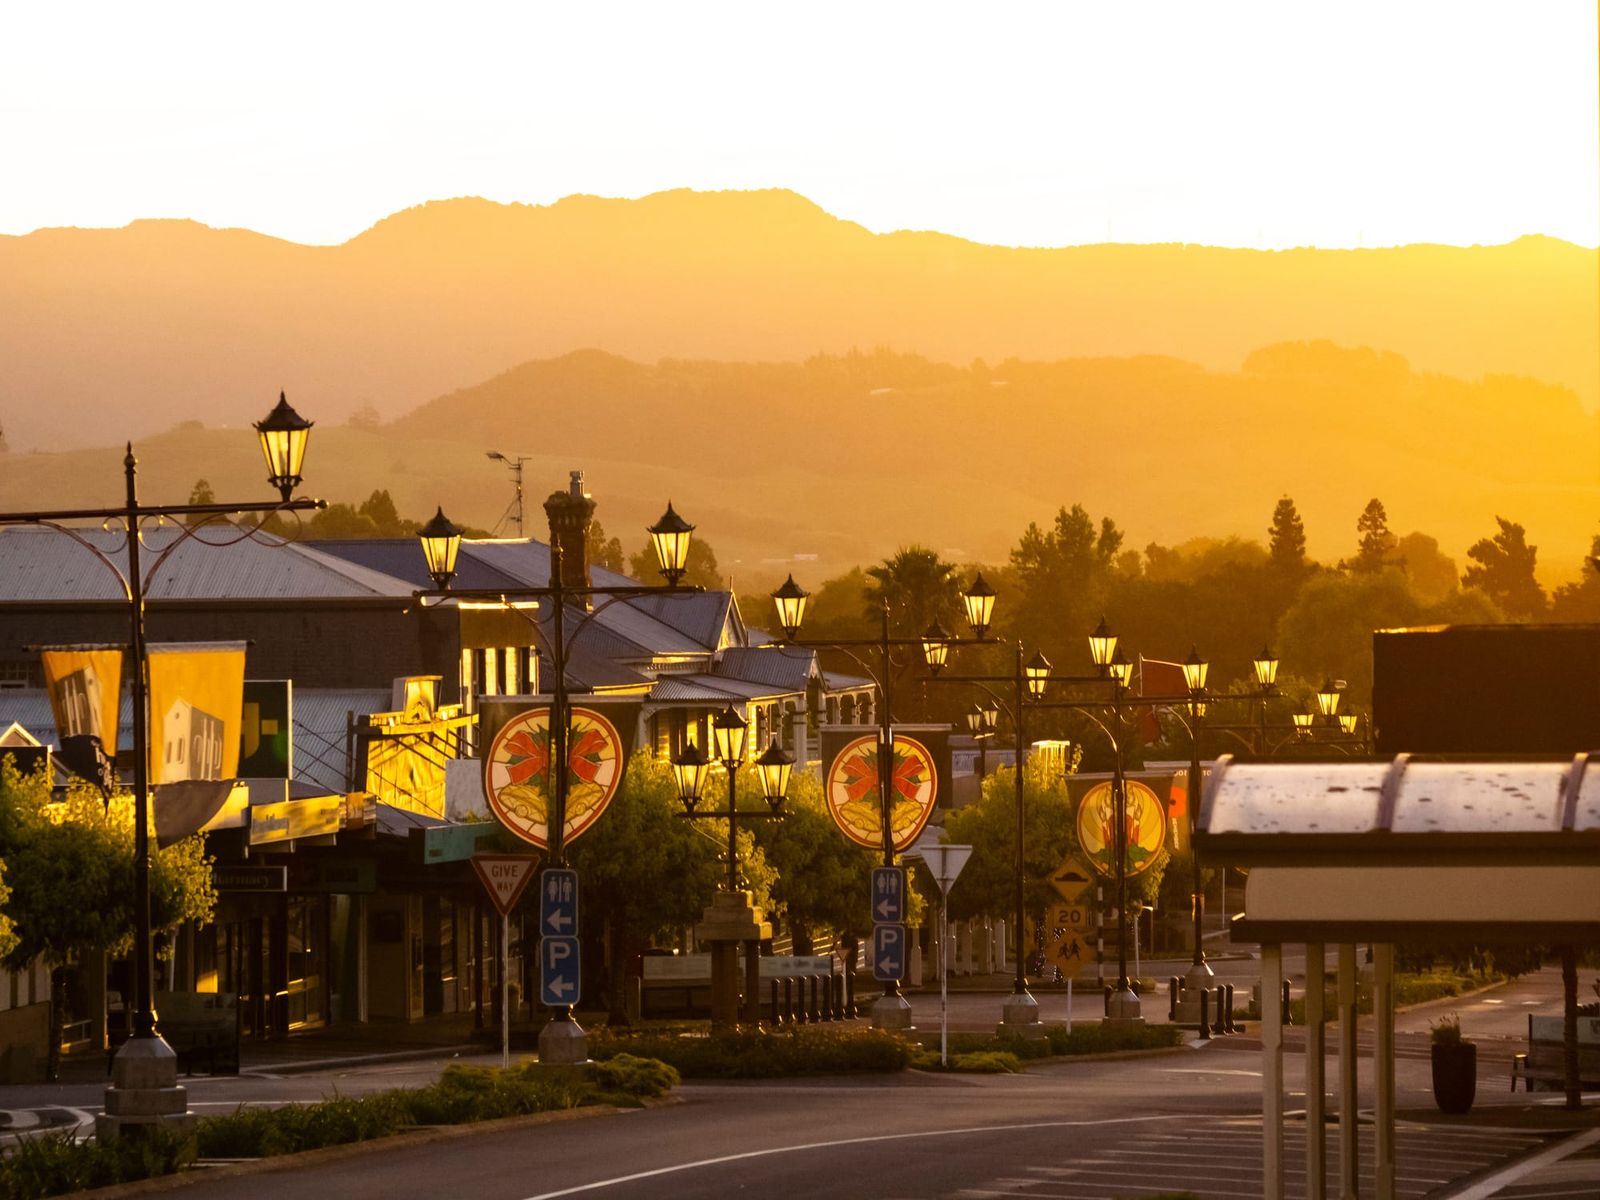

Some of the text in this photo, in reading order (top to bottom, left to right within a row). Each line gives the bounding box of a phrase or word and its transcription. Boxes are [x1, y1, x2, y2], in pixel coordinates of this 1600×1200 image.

[491, 864, 518, 878] GIVE
[213, 871, 269, 889] harmacy
[497, 882, 514, 891] WAY
[1059, 910, 1081, 923] 20
[880, 929, 898, 952] P
[549, 941, 570, 970] P
